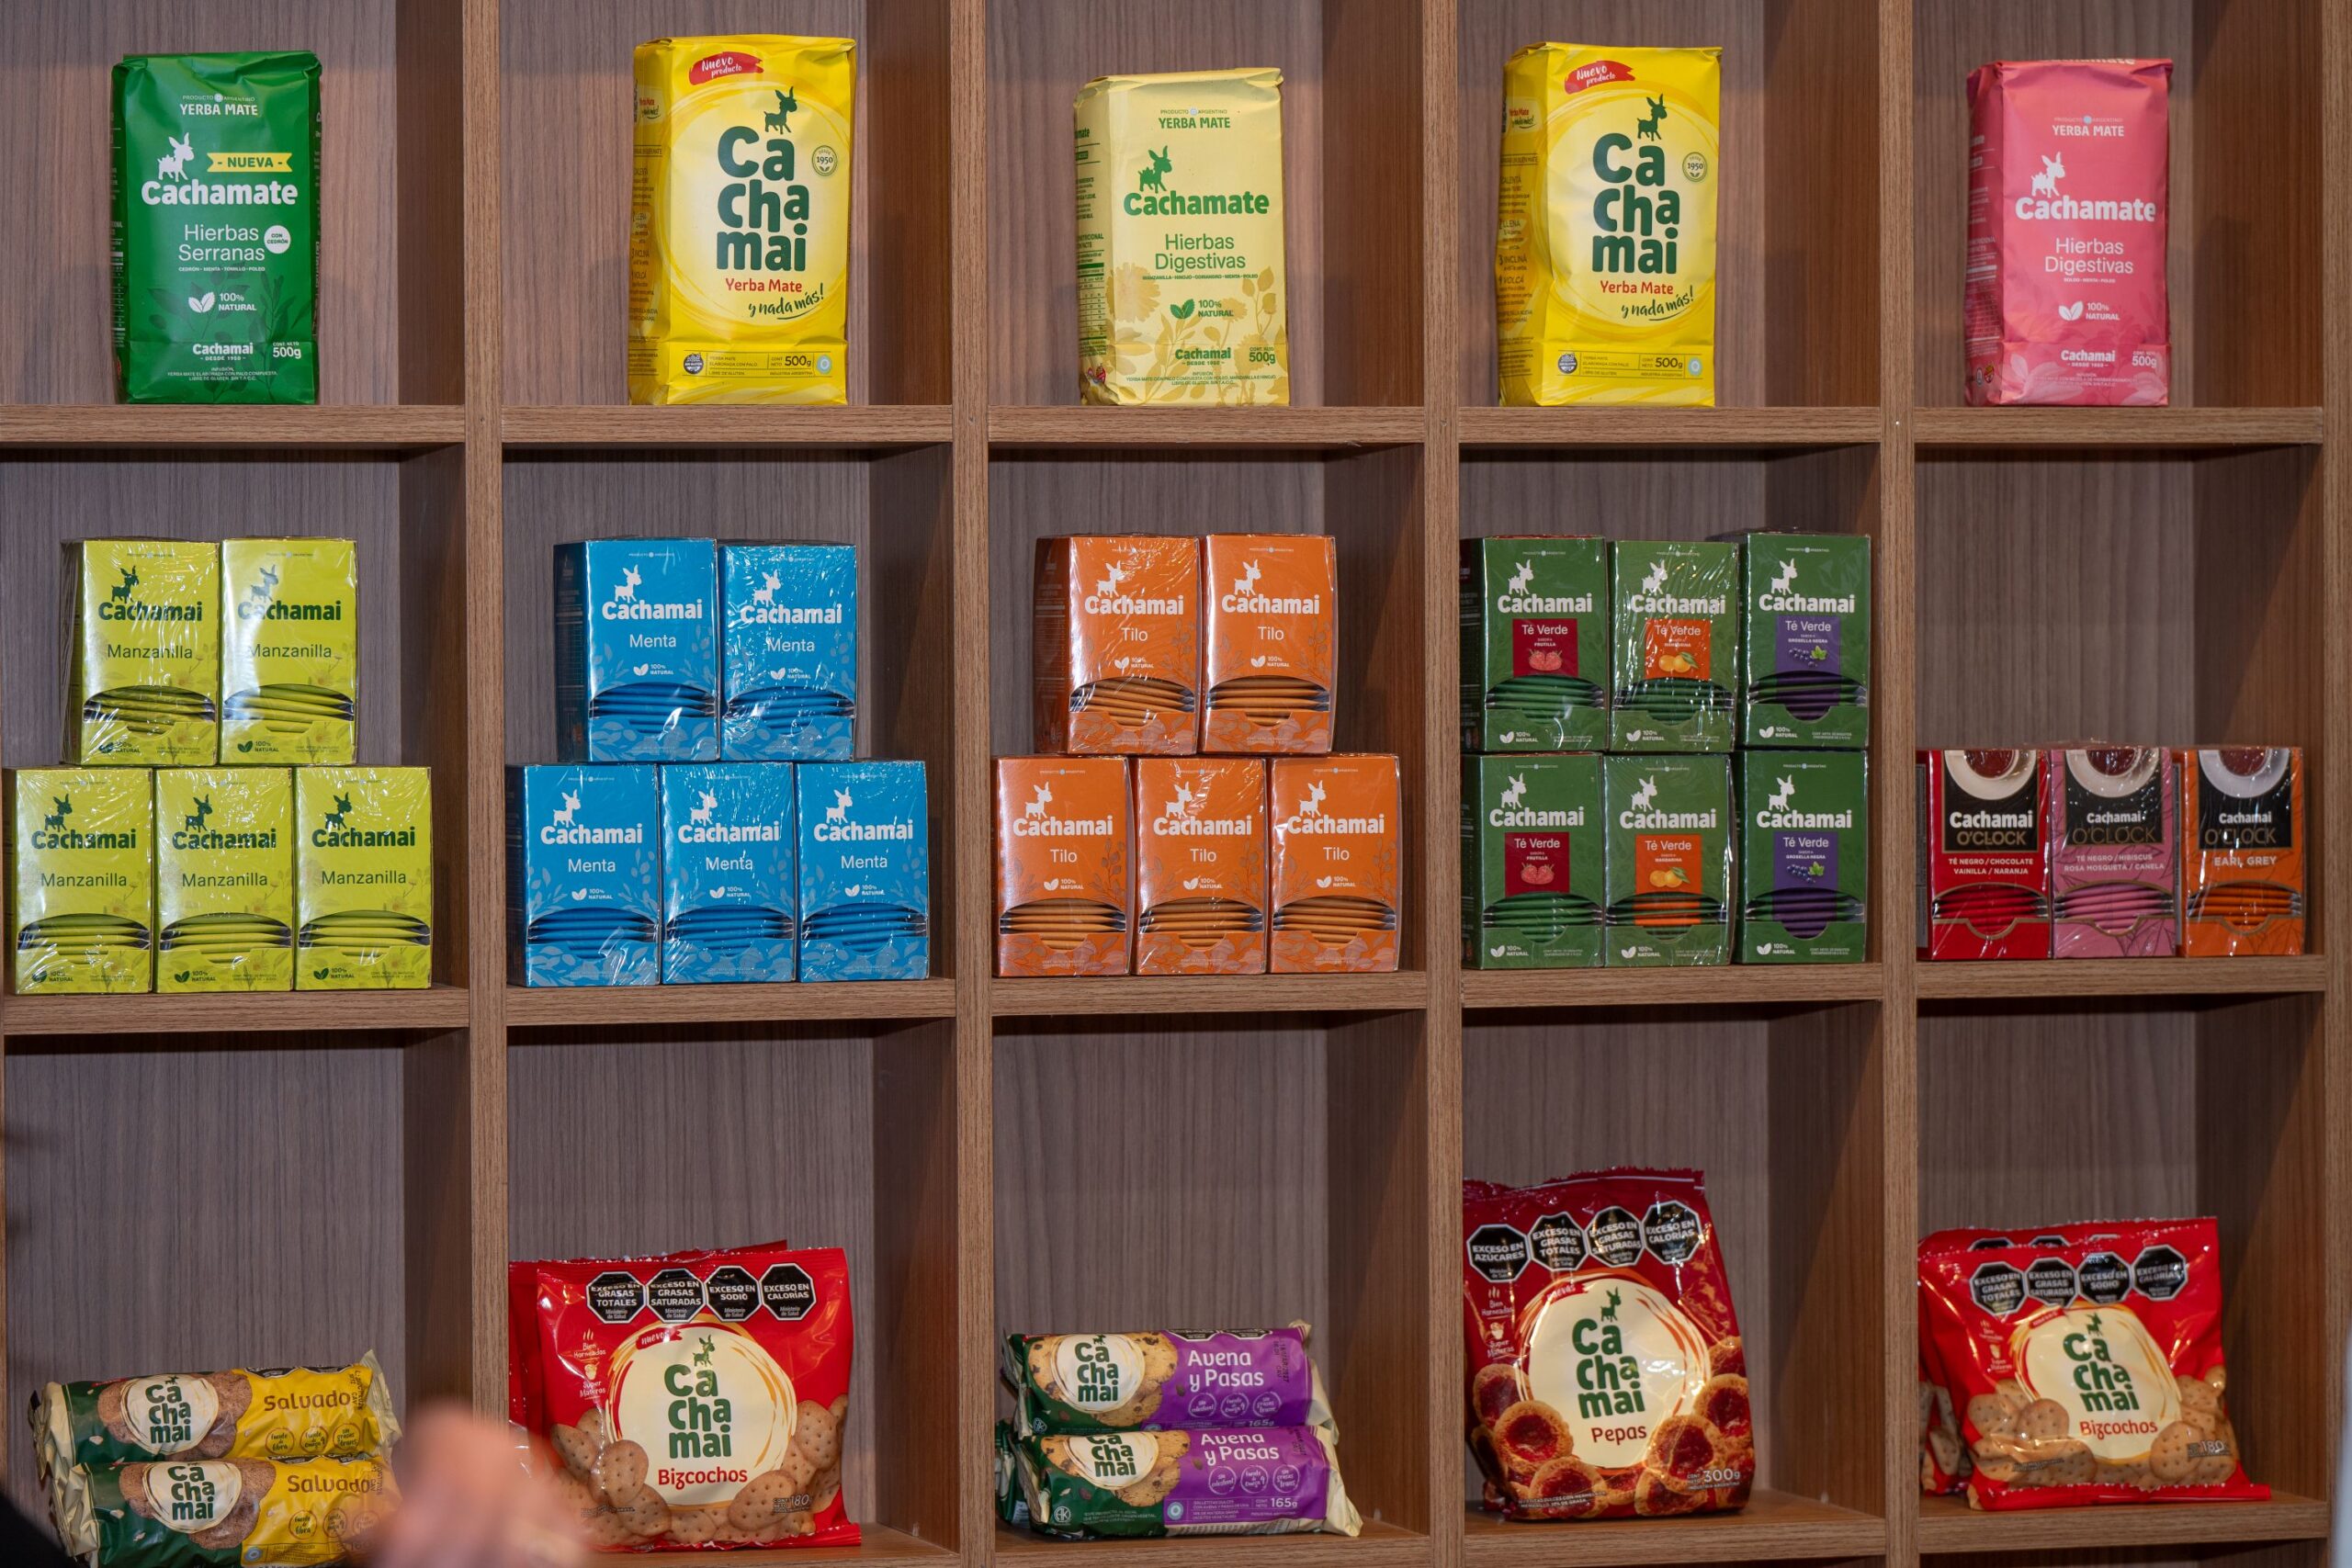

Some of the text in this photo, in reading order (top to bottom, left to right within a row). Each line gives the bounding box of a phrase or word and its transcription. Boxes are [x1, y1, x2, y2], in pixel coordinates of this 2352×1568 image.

[702, 57, 733, 71] Nuevo
[711, 64, 741, 77] producto
[1577, 65, 1607, 81] Nuevo
[180, 104, 258, 115] YERBA MATE
[1159, 118, 1230, 129] YERBA MATE
[2052, 125, 2124, 136] YERBA MATE
[228, 157, 273, 167] NUEVA
[816, 156, 833, 164] 1950
[1688, 163, 1703, 171] 1950
[141, 179, 298, 205] Cachamate
[1124, 190, 1269, 215] Cachamate
[2016, 196, 2156, 221] Cachamate
[185, 224, 258, 241] Hierbas
[717, 223, 808, 271] mai
[1166, 234, 1234, 250] Hierbas
[2056, 238, 2124, 254] Hierbas
[178, 244, 265, 261] Serranas
[1592, 230, 1678, 274] mai
[1156, 254, 1246, 272] Digestivas
[2045, 256, 2133, 276] Digestivas
[726, 278, 802, 292] Yerba Mate
[1600, 280, 1673, 295] Yerba Mate
[220, 293, 244, 301] 100%
[749, 303, 756, 317] y
[759, 299, 793, 314] nada
[1622, 305, 1628, 318] y
[1632, 300, 1664, 317] nada
[193, 343, 253, 355] Cachamai
[273, 347, 301, 358] 500g
[1175, 347, 1231, 359] Cachamai
[2061, 350, 2115, 363] Cachamai
[785, 355, 811, 367] 500g
[1249, 352, 1276, 364] 500g
[1655, 357, 1683, 368] 500g
[2132, 355, 2157, 367] 500g
[238, 600, 341, 621] Cachamai
[602, 599, 703, 620] Cachamai
[1085, 595, 1184, 615] Cachamai
[1221, 594, 1319, 615] Cachamai
[1498, 593, 1592, 613] Cachamai
[1632, 594, 1725, 615] Cachamai
[1759, 593, 1855, 614] Cachamai
[98, 601, 202, 621] Cachamai
[741, 604, 842, 624] Cachamai
[1258, 626, 1284, 640] Tilo
[1521, 625, 1568, 635] Té Verde
[1655, 625, 1701, 636] Té Verde
[1786, 621, 1832, 631] Té Verde
[629, 634, 676, 648] Menta
[1122, 627, 1148, 641] Tilo
[107, 645, 193, 659] Manzanilla
[249, 644, 332, 658] Manzanilla
[767, 637, 815, 652] Menta
[1287, 814, 1385, 834] Cachamai
[1489, 807, 1584, 827] Cachamai
[1620, 808, 1716, 829] Cachamai
[1757, 810, 1852, 829] Cachamai
[1950, 810, 2033, 829] Cachamai
[2086, 811, 2142, 824] Cachamai
[2219, 812, 2271, 823] Cachamai
[678, 821, 780, 843] Cachamai
[813, 819, 913, 841] Cachamai
[1012, 816, 1114, 836] Cachamai
[1154, 816, 1251, 836] Cachamai
[31, 829, 136, 850] Cachamai
[172, 829, 277, 850] Cachamai
[312, 827, 415, 847] Cachamai
[540, 823, 642, 845] Cachamai
[1514, 839, 1560, 848] Té Verde
[1645, 840, 1691, 850] Té Verde
[1783, 838, 1829, 847] Té Verde
[842, 855, 888, 868] Menta
[1050, 849, 1077, 863] Tilo
[1191, 849, 1216, 863] Tilo
[1323, 847, 1350, 861] Tilo
[2247, 856, 2277, 865] GREY
[568, 858, 616, 873] Menta
[706, 857, 753, 871] Menta
[41, 873, 127, 886] Manzanilla
[183, 873, 267, 886] Manzanilla
[322, 871, 406, 885] Manzanilla
[1540, 1238, 1577, 1247] GRASAS
[1540, 1247, 1580, 1257] TOTALES
[764, 1284, 794, 1292] EXCESO
[2091, 1280, 2119, 1289] SODIO
[598, 1289, 635, 1298] GRASAS
[658, 1289, 694, 1297] GRASAS
[767, 1291, 809, 1301] CALORÍAS
[596, 1298, 637, 1306] TOTALES
[650, 1298, 701, 1306] SATURADAS
[1188, 1349, 1252, 1367] Avena
[1190, 1369, 1264, 1393] y Pasas
[1078, 1381, 1119, 1403] mai
[2079, 1385, 2140, 1413] mai
[1577, 1382, 1645, 1419] mai
[150, 1419, 191, 1444] mai
[1591, 1424, 1646, 1445] Pepas
[2080, 1420, 2158, 1440] Bizcochos
[668, 1426, 732, 1459] mai
[1204, 1447, 1280, 1467] y Pasas
[1094, 1457, 1136, 1478] mai
[658, 1467, 748, 1490] Bizcochos
[1703, 1469, 1740, 1482] 300g
[172, 1495, 214, 1521] mai
[1271, 1498, 1297, 1507] 165g
